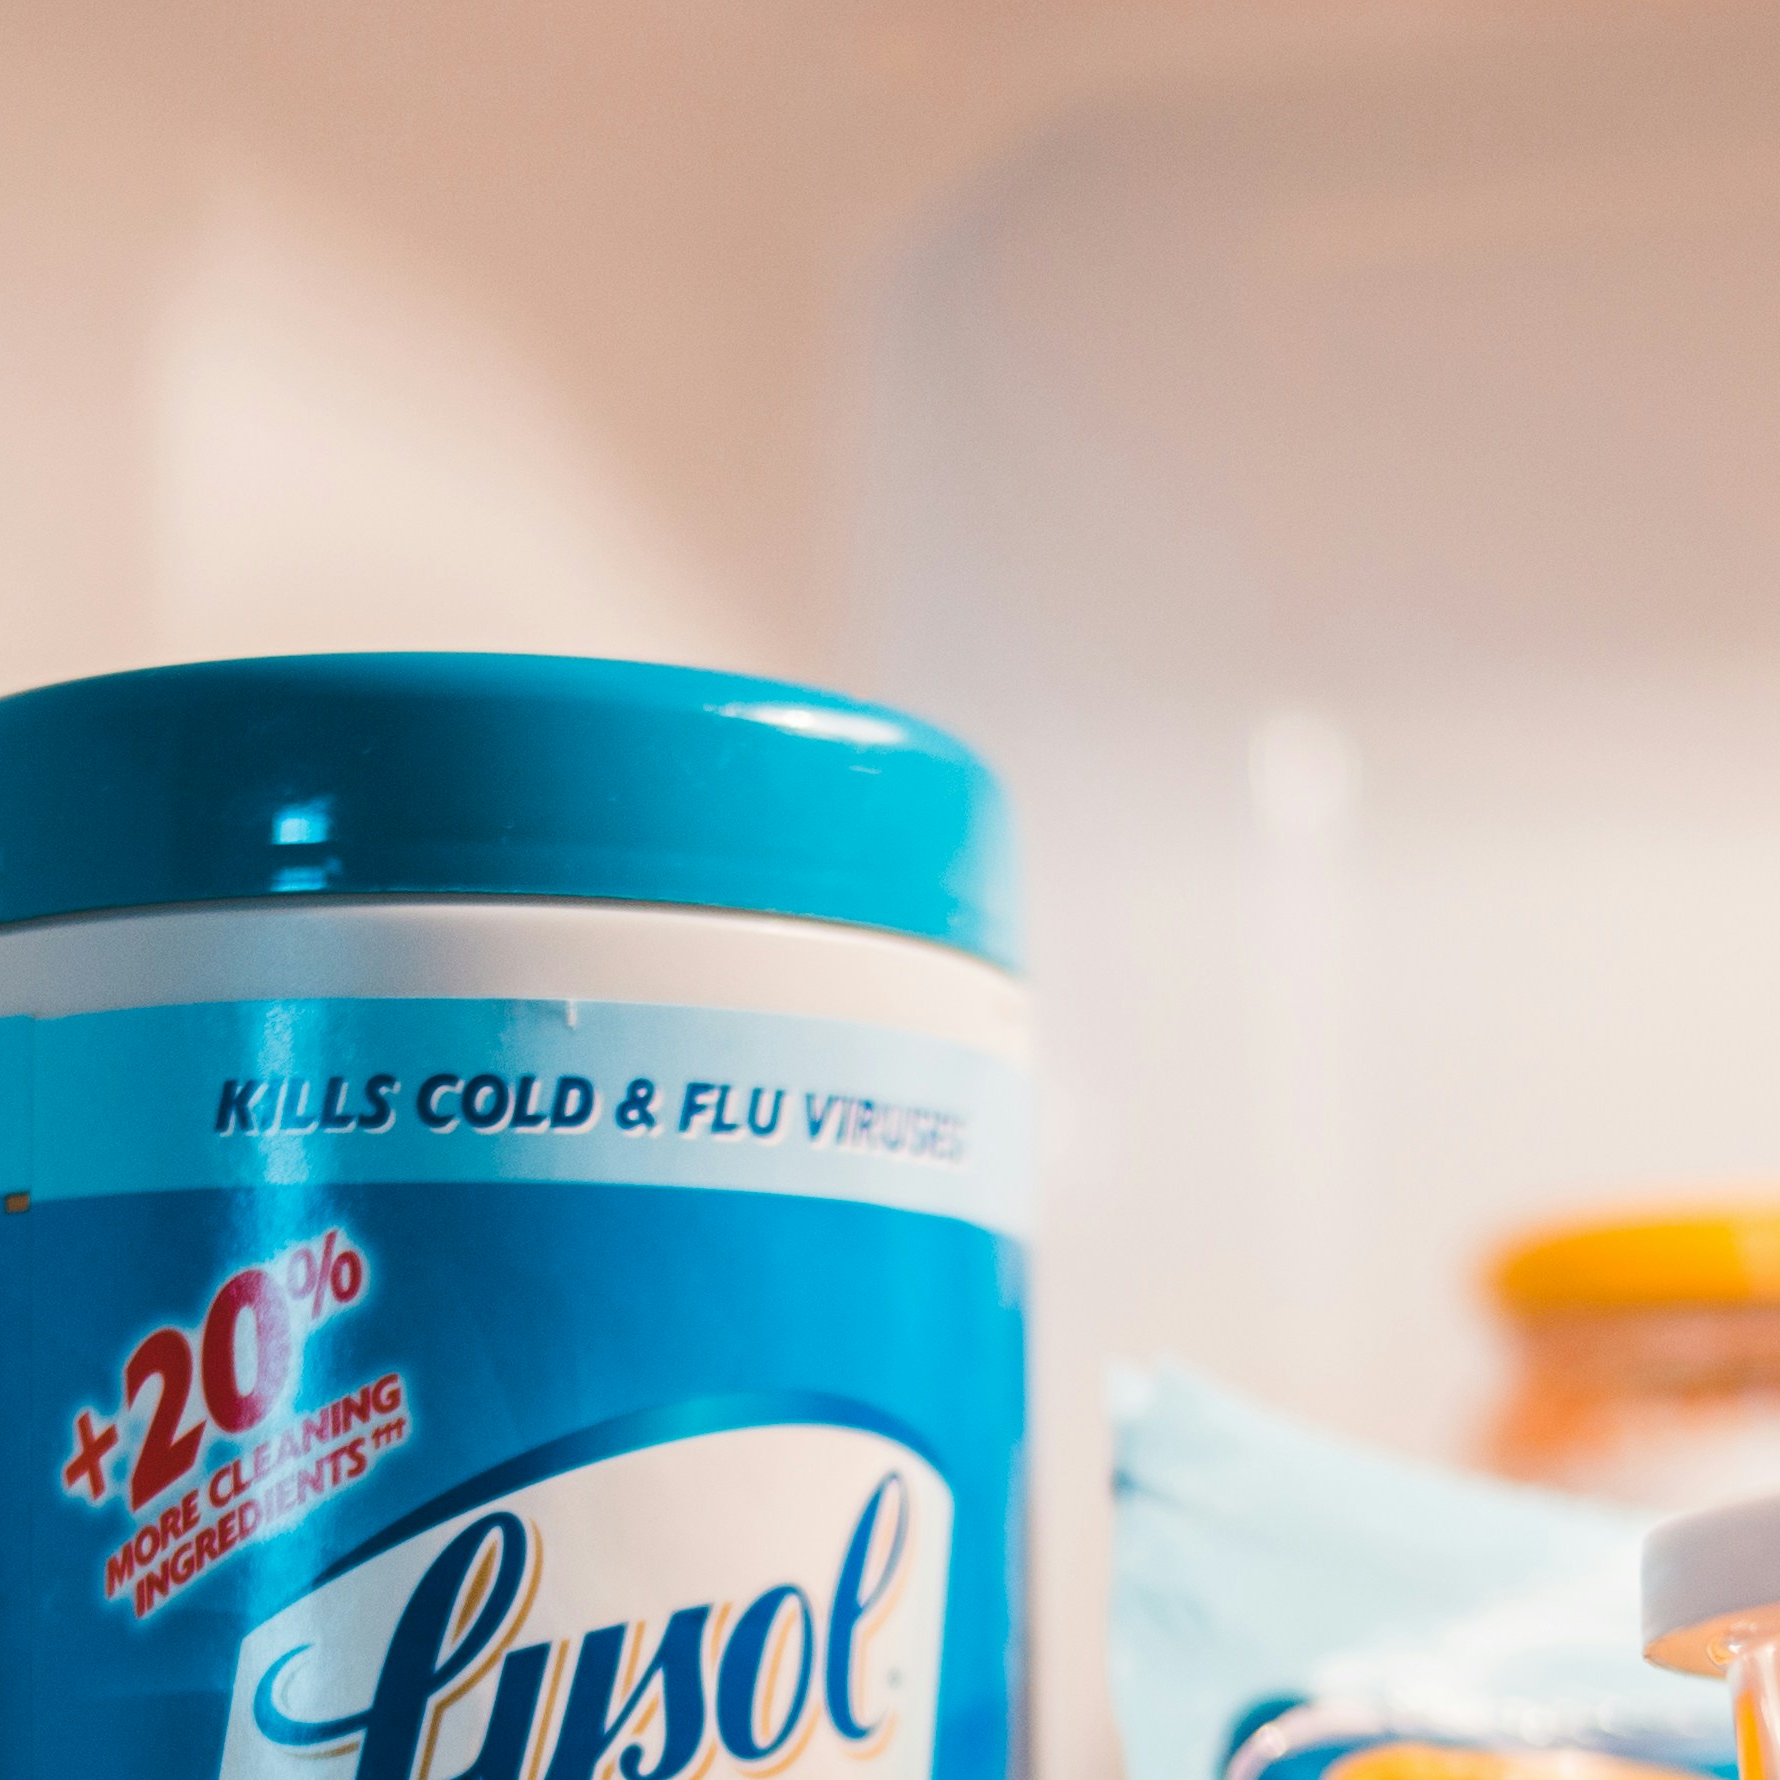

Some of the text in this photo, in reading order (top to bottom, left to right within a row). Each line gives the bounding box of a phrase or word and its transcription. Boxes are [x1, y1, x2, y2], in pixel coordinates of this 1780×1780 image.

[216, 1073, 396, 1136] KILLS
[417, 1072, 597, 1136] COLD
[615, 1077, 659, 1136] &
[678, 1080, 787, 1142] FLU
[63, 1229, 363, 1514] +20%
[106, 1372, 402, 1599] MORE CLEANING
